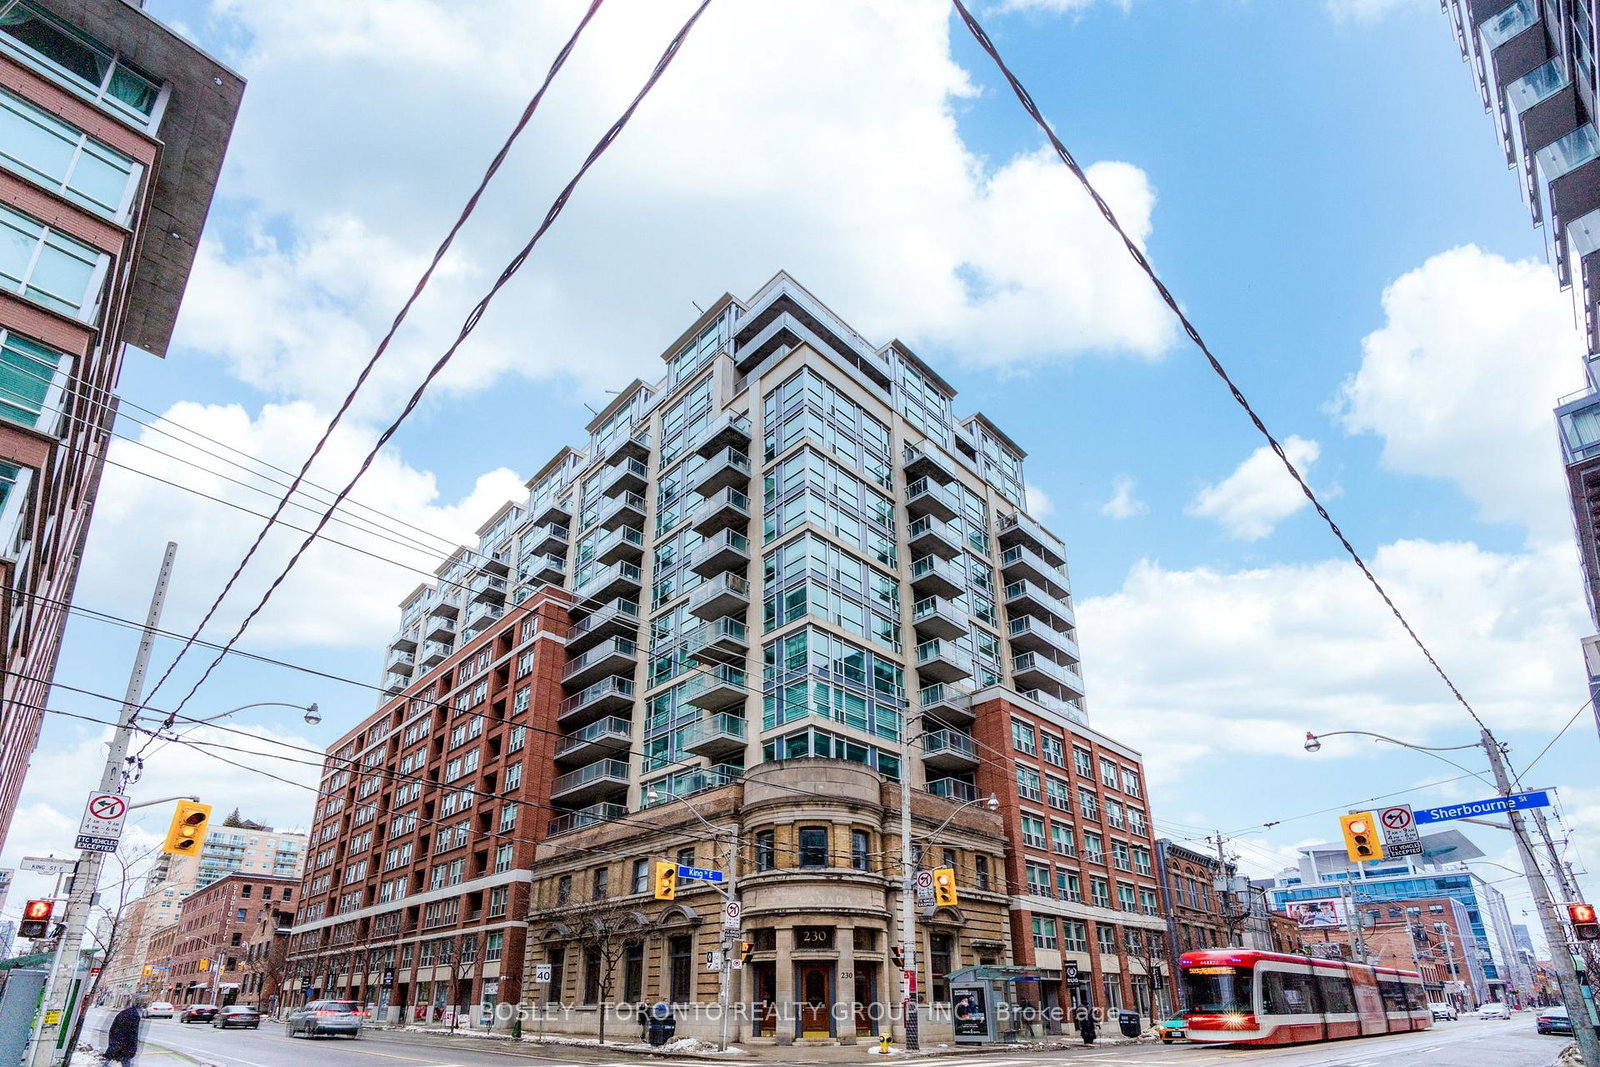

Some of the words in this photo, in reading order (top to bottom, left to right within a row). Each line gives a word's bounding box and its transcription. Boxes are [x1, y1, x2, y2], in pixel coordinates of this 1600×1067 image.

[1430, 798, 1517, 821] Sherbourne
[77, 842, 115, 851] EXCEPTED
[91, 838, 118, 846] VEHICLES
[1390, 847, 1421, 857] EXCEPTED
[689, 868, 704, 879] King
[708, 871, 714, 879] E
[227, 883, 239, 917] STUDIO
[798, 894, 853, 906] CANADA
[223, 919, 232, 941] CITY
[803, 930, 828, 942] 230
[536, 971, 551, 981] 40
[840, 971, 854, 980] 230
